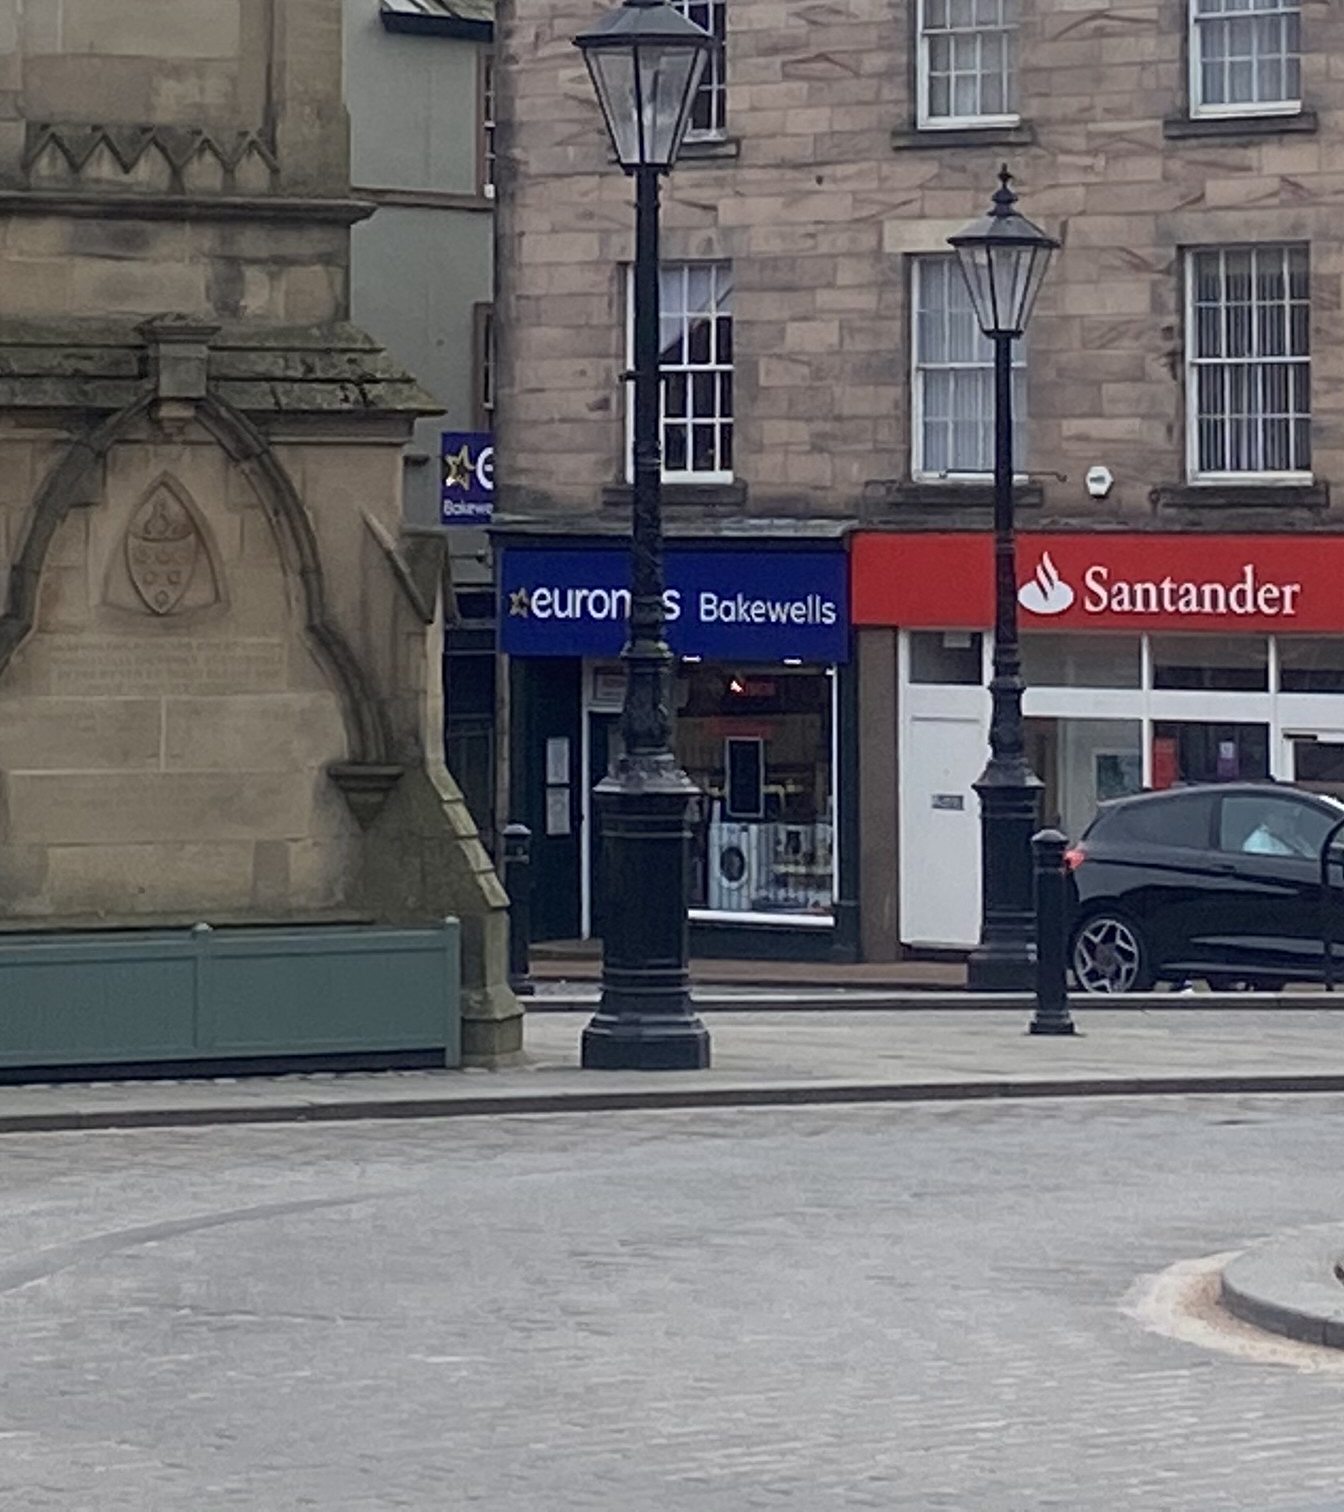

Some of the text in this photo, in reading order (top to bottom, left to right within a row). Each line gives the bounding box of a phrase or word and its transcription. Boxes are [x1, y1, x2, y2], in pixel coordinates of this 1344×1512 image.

[529, 587, 837, 625] eurons Bakewells
[1083, 563, 1302, 617] Santander
